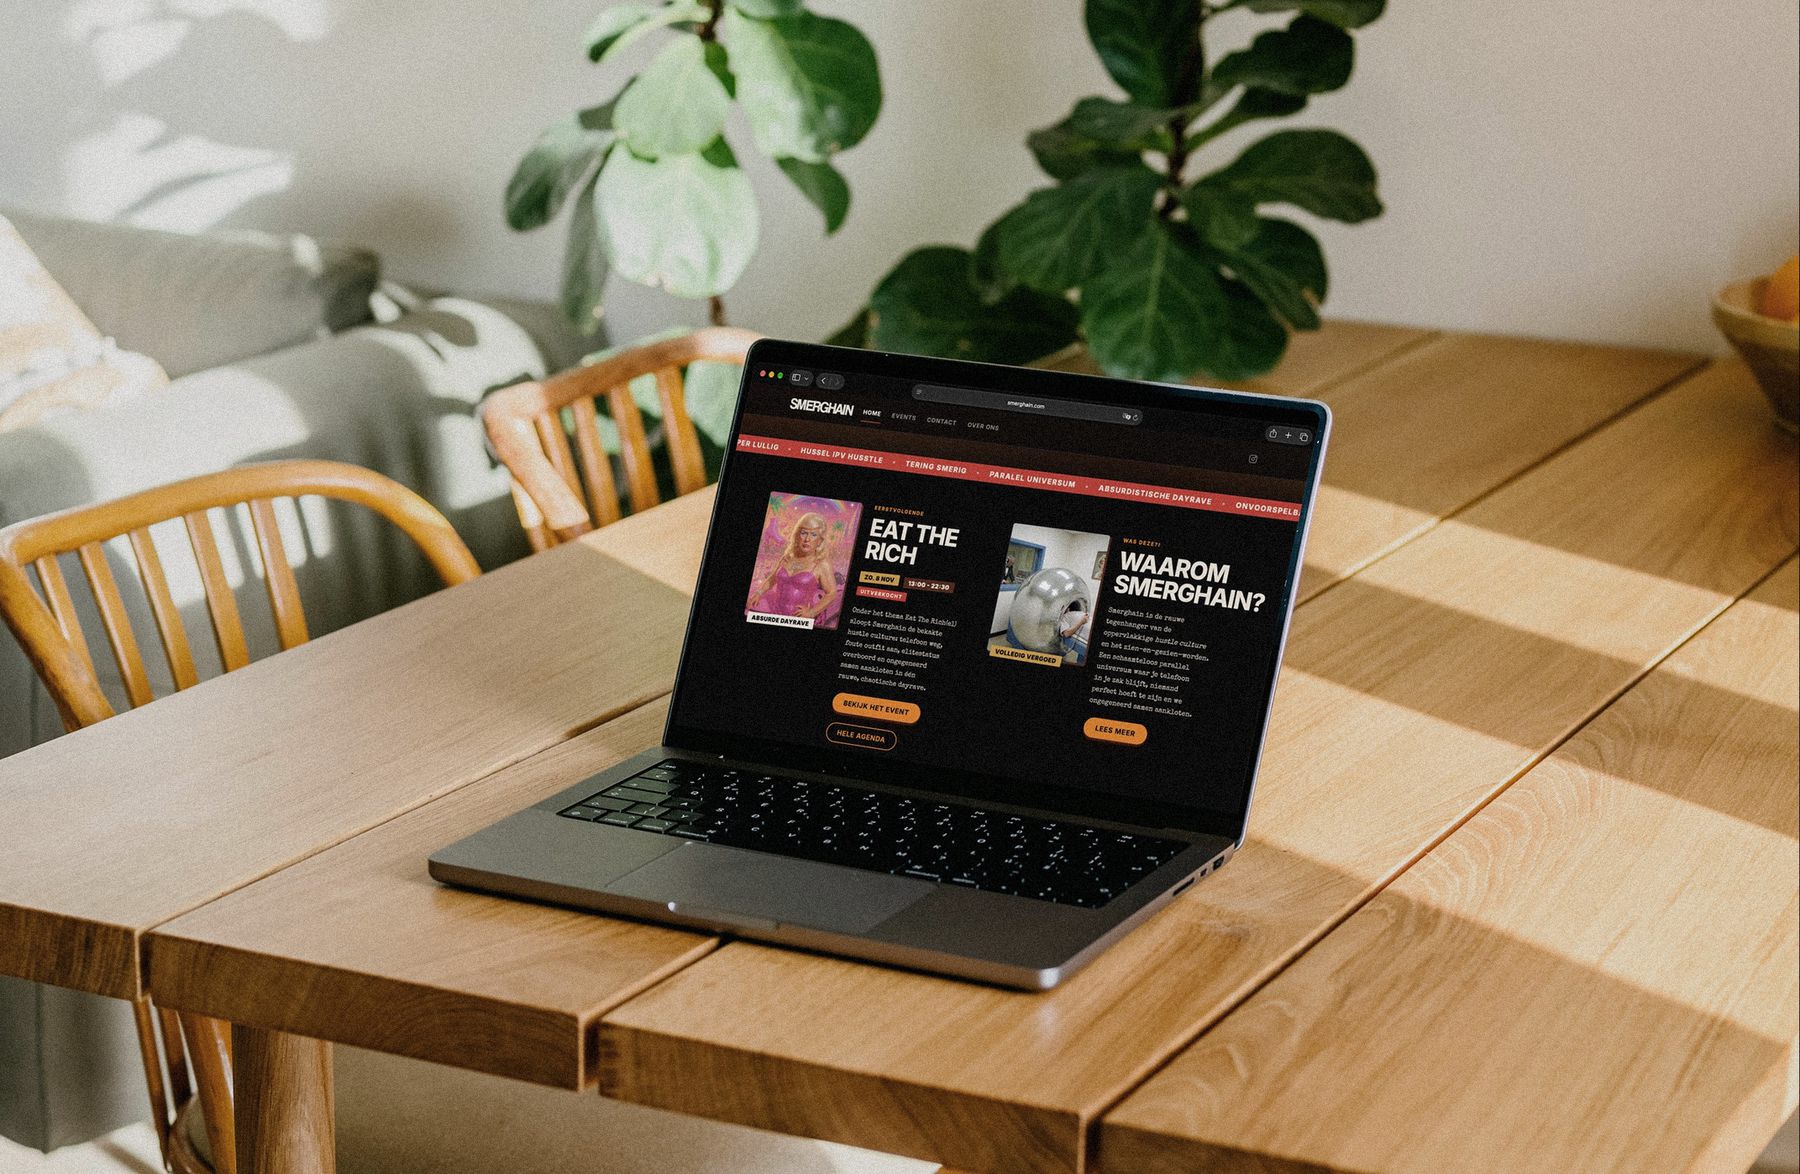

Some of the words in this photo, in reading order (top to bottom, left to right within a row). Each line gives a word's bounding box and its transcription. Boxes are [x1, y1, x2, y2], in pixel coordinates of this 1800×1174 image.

[790, 398, 854, 416] SMERGHAIN
[862, 409, 882, 417] HOME
[1007, 400, 1045, 410] smerghain.com
[891, 412, 916, 421] EVENTS
[926, 417, 956, 426] CONTACT
[968, 422, 984, 430] OVER
[737, 439, 750, 447] PER
[752, 441, 779, 450] LULLIG
[800, 447, 830, 457] HUSSEL
[832, 451, 846, 459] IPV
[848, 453, 884, 464] HUSSTLE
[906, 460, 934, 470] TERING
[936, 464, 966, 474] SMERIG
[989, 470, 1024, 482] PARALEL
[1026, 476, 1076, 488] UNIVERSUM
[1098, 484, 1170, 500] ABSURDISTISCHE
[1172, 494, 1212, 505] DAYRAVE
[1236, 502, 1300, 516] ONVOORSPELB
[874, 505, 924, 516] EERSTVOLGENDE
[870, 518, 914, 540] EAT
[916, 524, 960, 548] THE
[864, 540, 918, 566] RICH
[1120, 551, 1230, 584] WAAROM
[860, 589, 902, 599] UITVERKOCHT
[1114, 574, 1266, 612] SMERGHAIN?
[752, 614, 780, 624] ABSURDE
[780, 618, 810, 626] DAYRAVE
[852, 606, 871, 615] Onder
[885, 612, 904, 620] thema
[918, 616, 930, 624] The
[1108, 606, 1144, 618] Smerghain
[1164, 615, 1184, 623] rauwe
[850, 618, 871, 627] sloopt
[872, 620, 906, 632] Smerghain
[908, 625, 916, 633] de
[916, 627, 942, 636] bekakte
[1106, 618, 1148, 630] tegenhanger
[848, 628, 869, 638] hustle
[900, 636, 928, 646] telefoon
[1104, 630, 1154, 642] oppervlakkige
[1155, 636, 1178, 646] hustle
[1180, 640, 1207, 650] culture
[845, 640, 862, 648] foute
[864, 642, 885, 651] outfit
[902, 648, 940, 659] elitestatus
[995, 648, 1026, 659] VOLLEDIG
[1026, 654, 1056, 664] VERGOED
[842, 652, 876, 661] overboord
[886, 657, 928, 668] ongegeneerd
[1098, 652, 1111, 660] Een
[1112, 654, 1158, 666] schaamteloos
[1159, 660, 1190, 671] parallel
[860, 664, 894, 674] aankloten
[1096, 664, 1132, 674] universum
[1150, 670, 1158, 678] je
[1160, 671, 1190, 682] telefoon
[860, 676, 896, 686] chaotische
[898, 681, 926, 691] dayrave.
[1150, 681, 1178, 692] niemand
[1091, 686, 1118, 695] perfect
[1118, 688, 1137, 698] hoeft
[1147, 694, 1162, 702] zijn
[842, 700, 868, 710] BEKIJK
[886, 706, 910, 716] EVENT
[1088, 698, 1132, 708] ongegeneerd
[1132, 704, 1154, 712] samen
[1154, 705, 1192, 718] aankloten.
[836, 730, 854, 738] HELE
[856, 732, 885, 743] AGENDA
[1094, 725, 1114, 734] LEES
[1114, 728, 1136, 736] MEER
